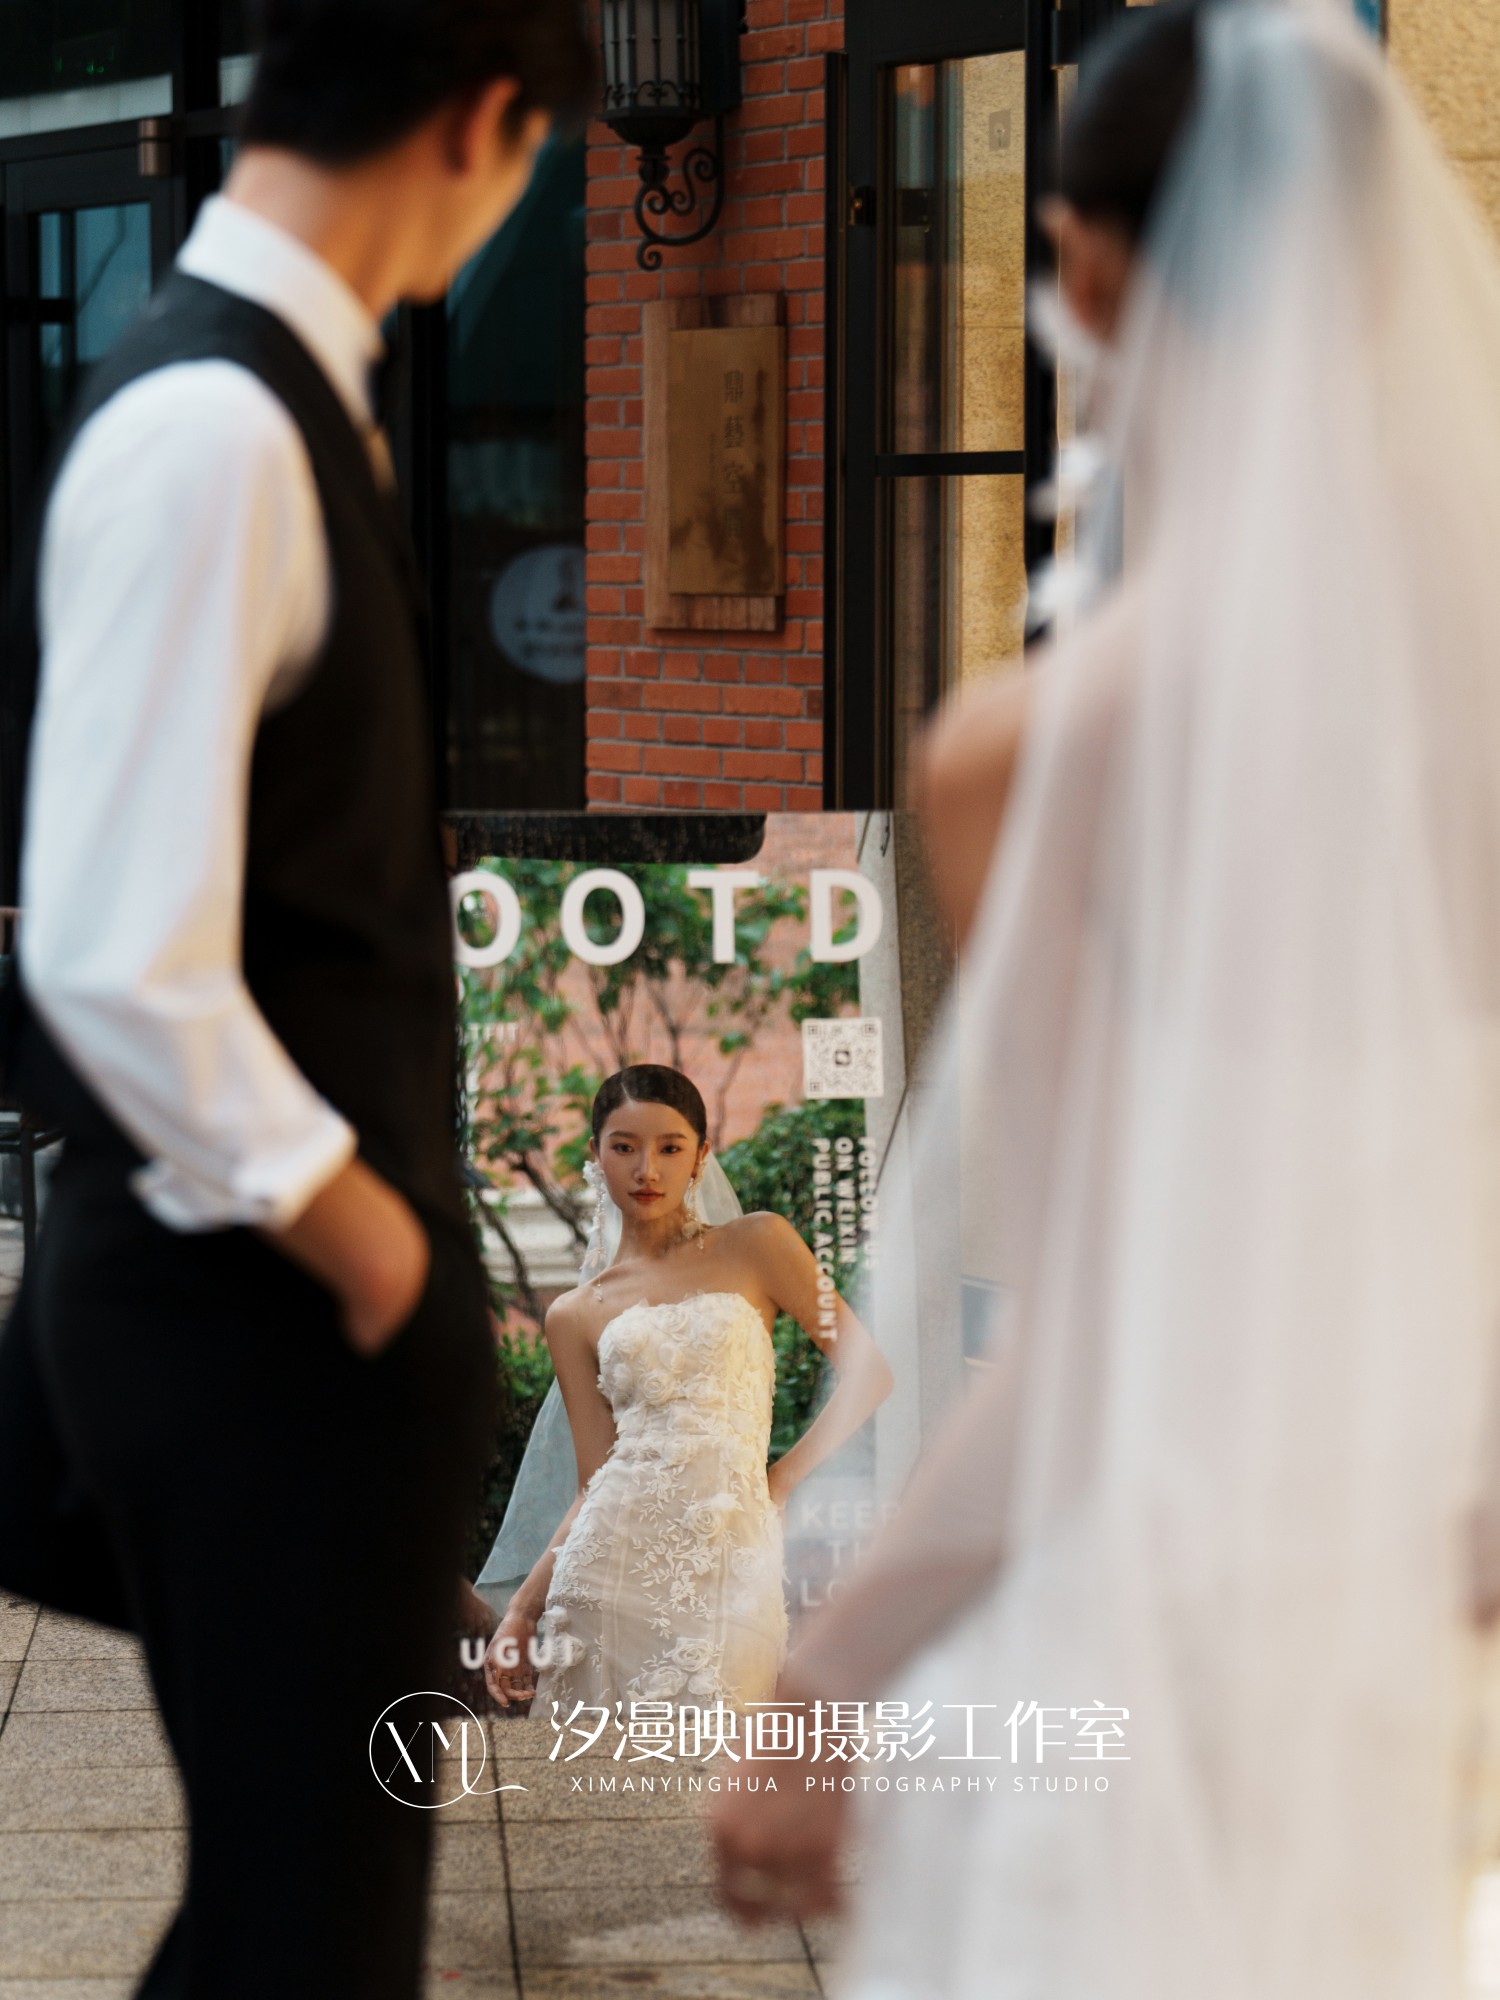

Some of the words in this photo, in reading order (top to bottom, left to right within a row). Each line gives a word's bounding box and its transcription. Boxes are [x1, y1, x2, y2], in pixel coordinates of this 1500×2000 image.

[449, 868, 884, 967] OOTD
[812, 1138, 833, 1225] PUBLIC
[835, 1136, 854, 1171] ON
[858, 1137, 878, 1231] FOLLOW
[836, 1178, 857, 1263] WEIXIN
[814, 1231, 838, 1341] ACCOUNT
